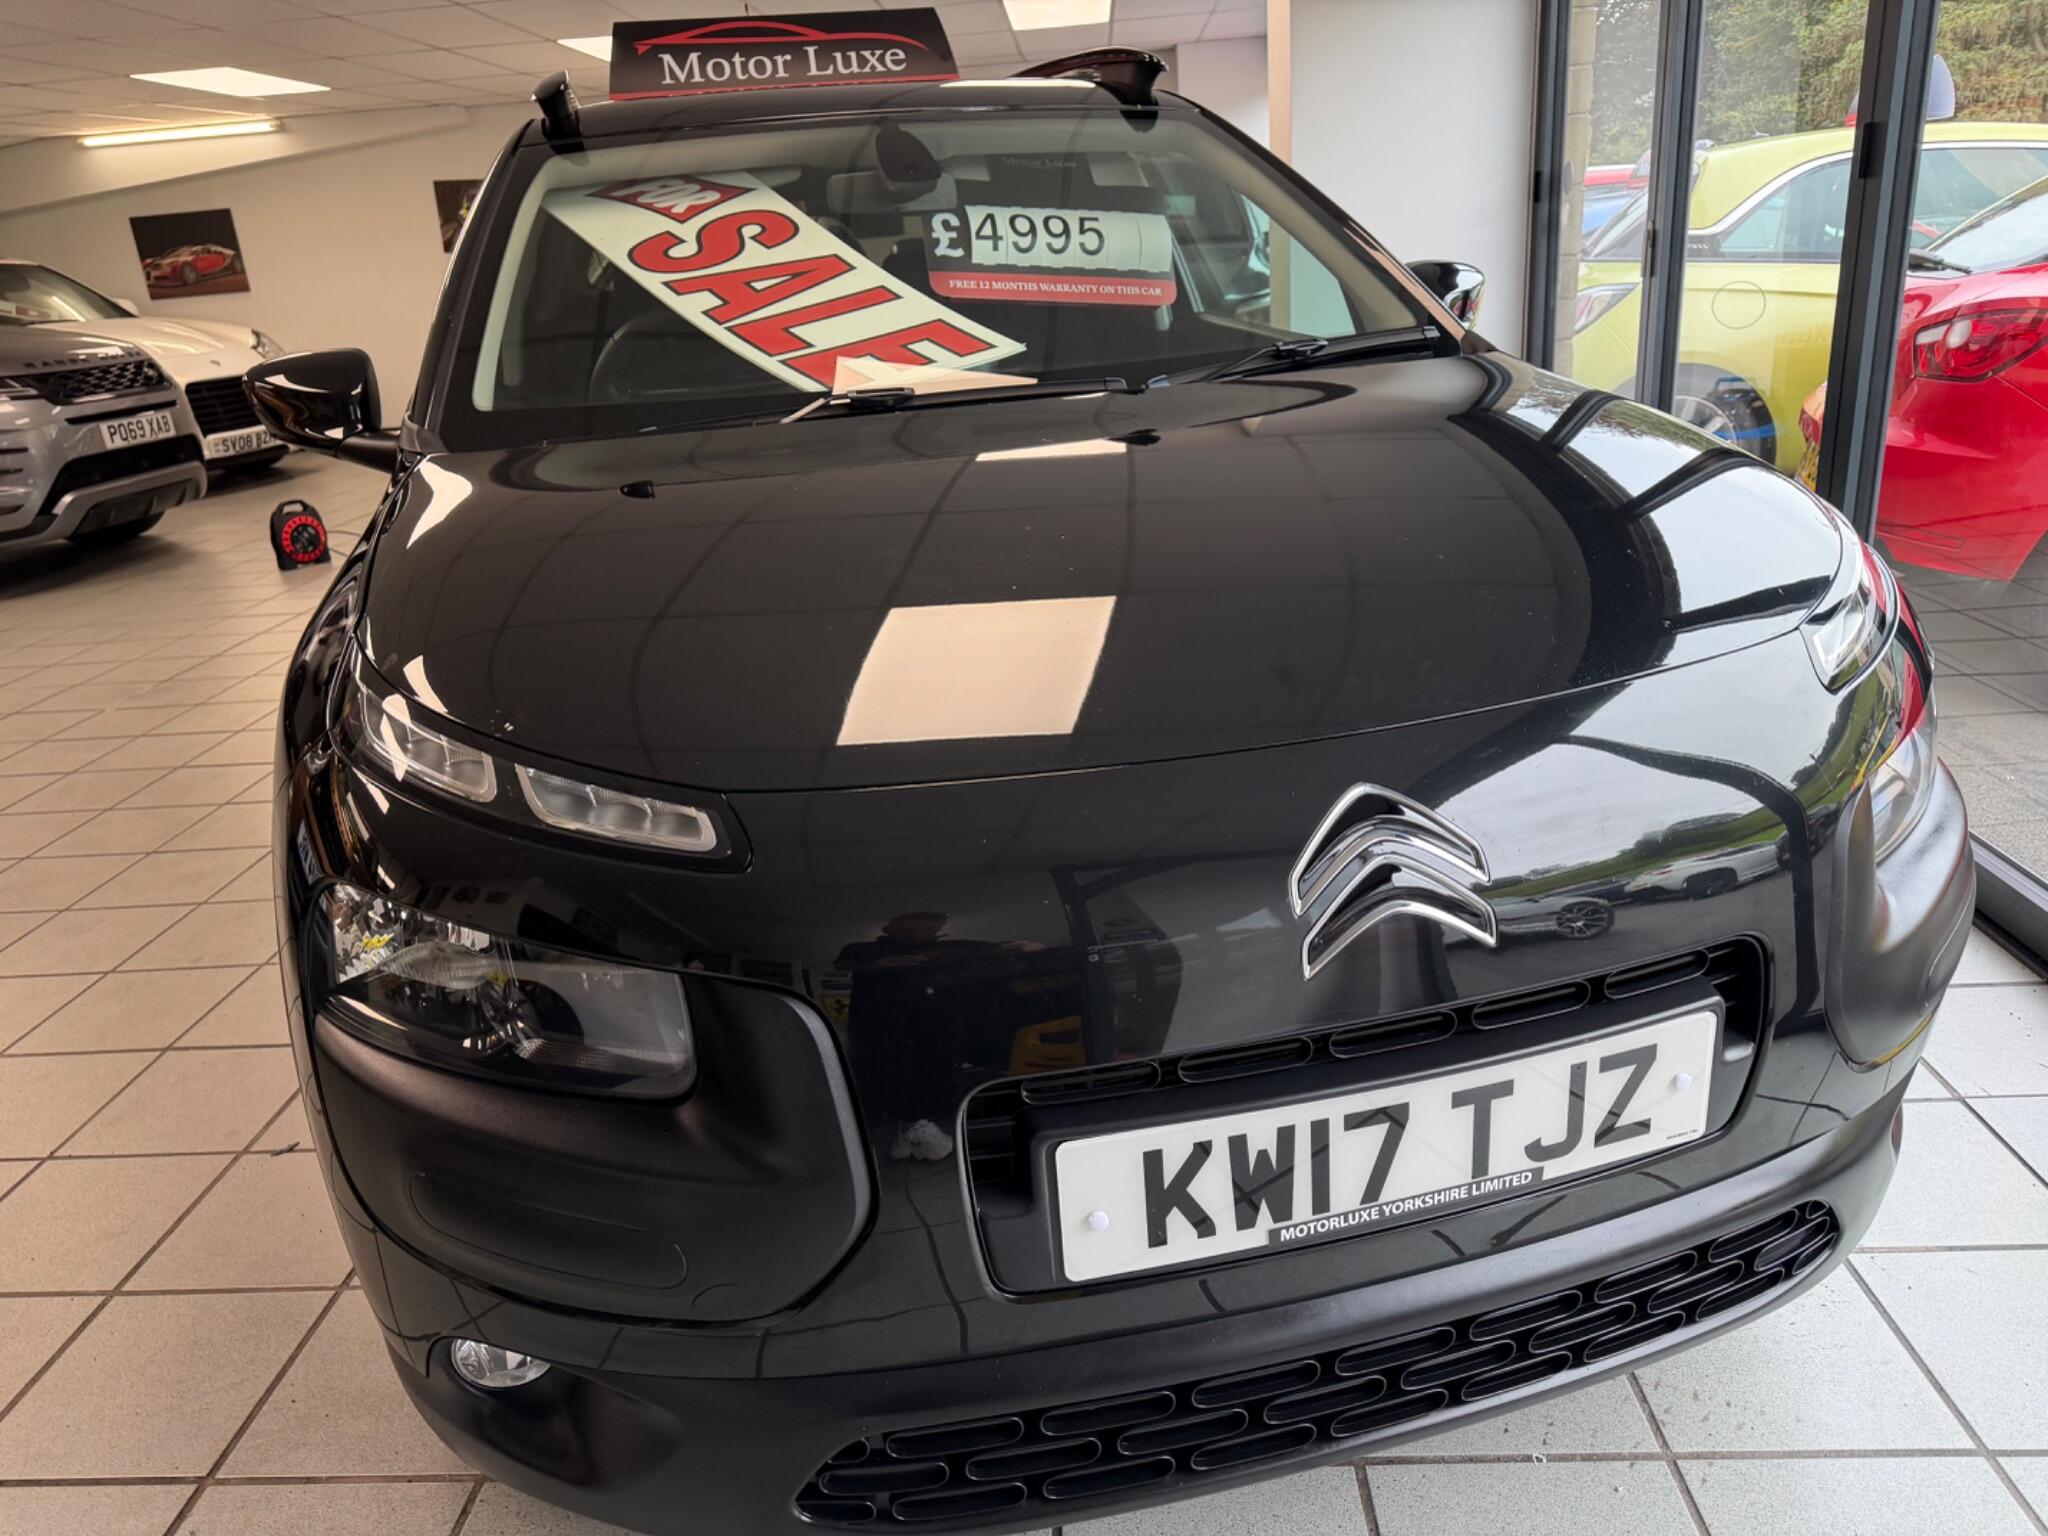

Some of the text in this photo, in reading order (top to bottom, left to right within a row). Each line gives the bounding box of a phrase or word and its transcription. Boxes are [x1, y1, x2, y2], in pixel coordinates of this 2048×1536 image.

[658, 45, 908, 85] Motor Luxe
[608, 177, 722, 214] FOR
[626, 208, 999, 391] SALE
[948, 279, 1163, 297] FREE 12 MONTHS WARRANTY ON THIS CAR
[106, 414, 172, 444] PO69 XAB
[1142, 1044, 1658, 1248] KW17 TJZ
[1280, 1171, 1533, 1242] MOTORLUXE YORKSHIRE LIMITED
